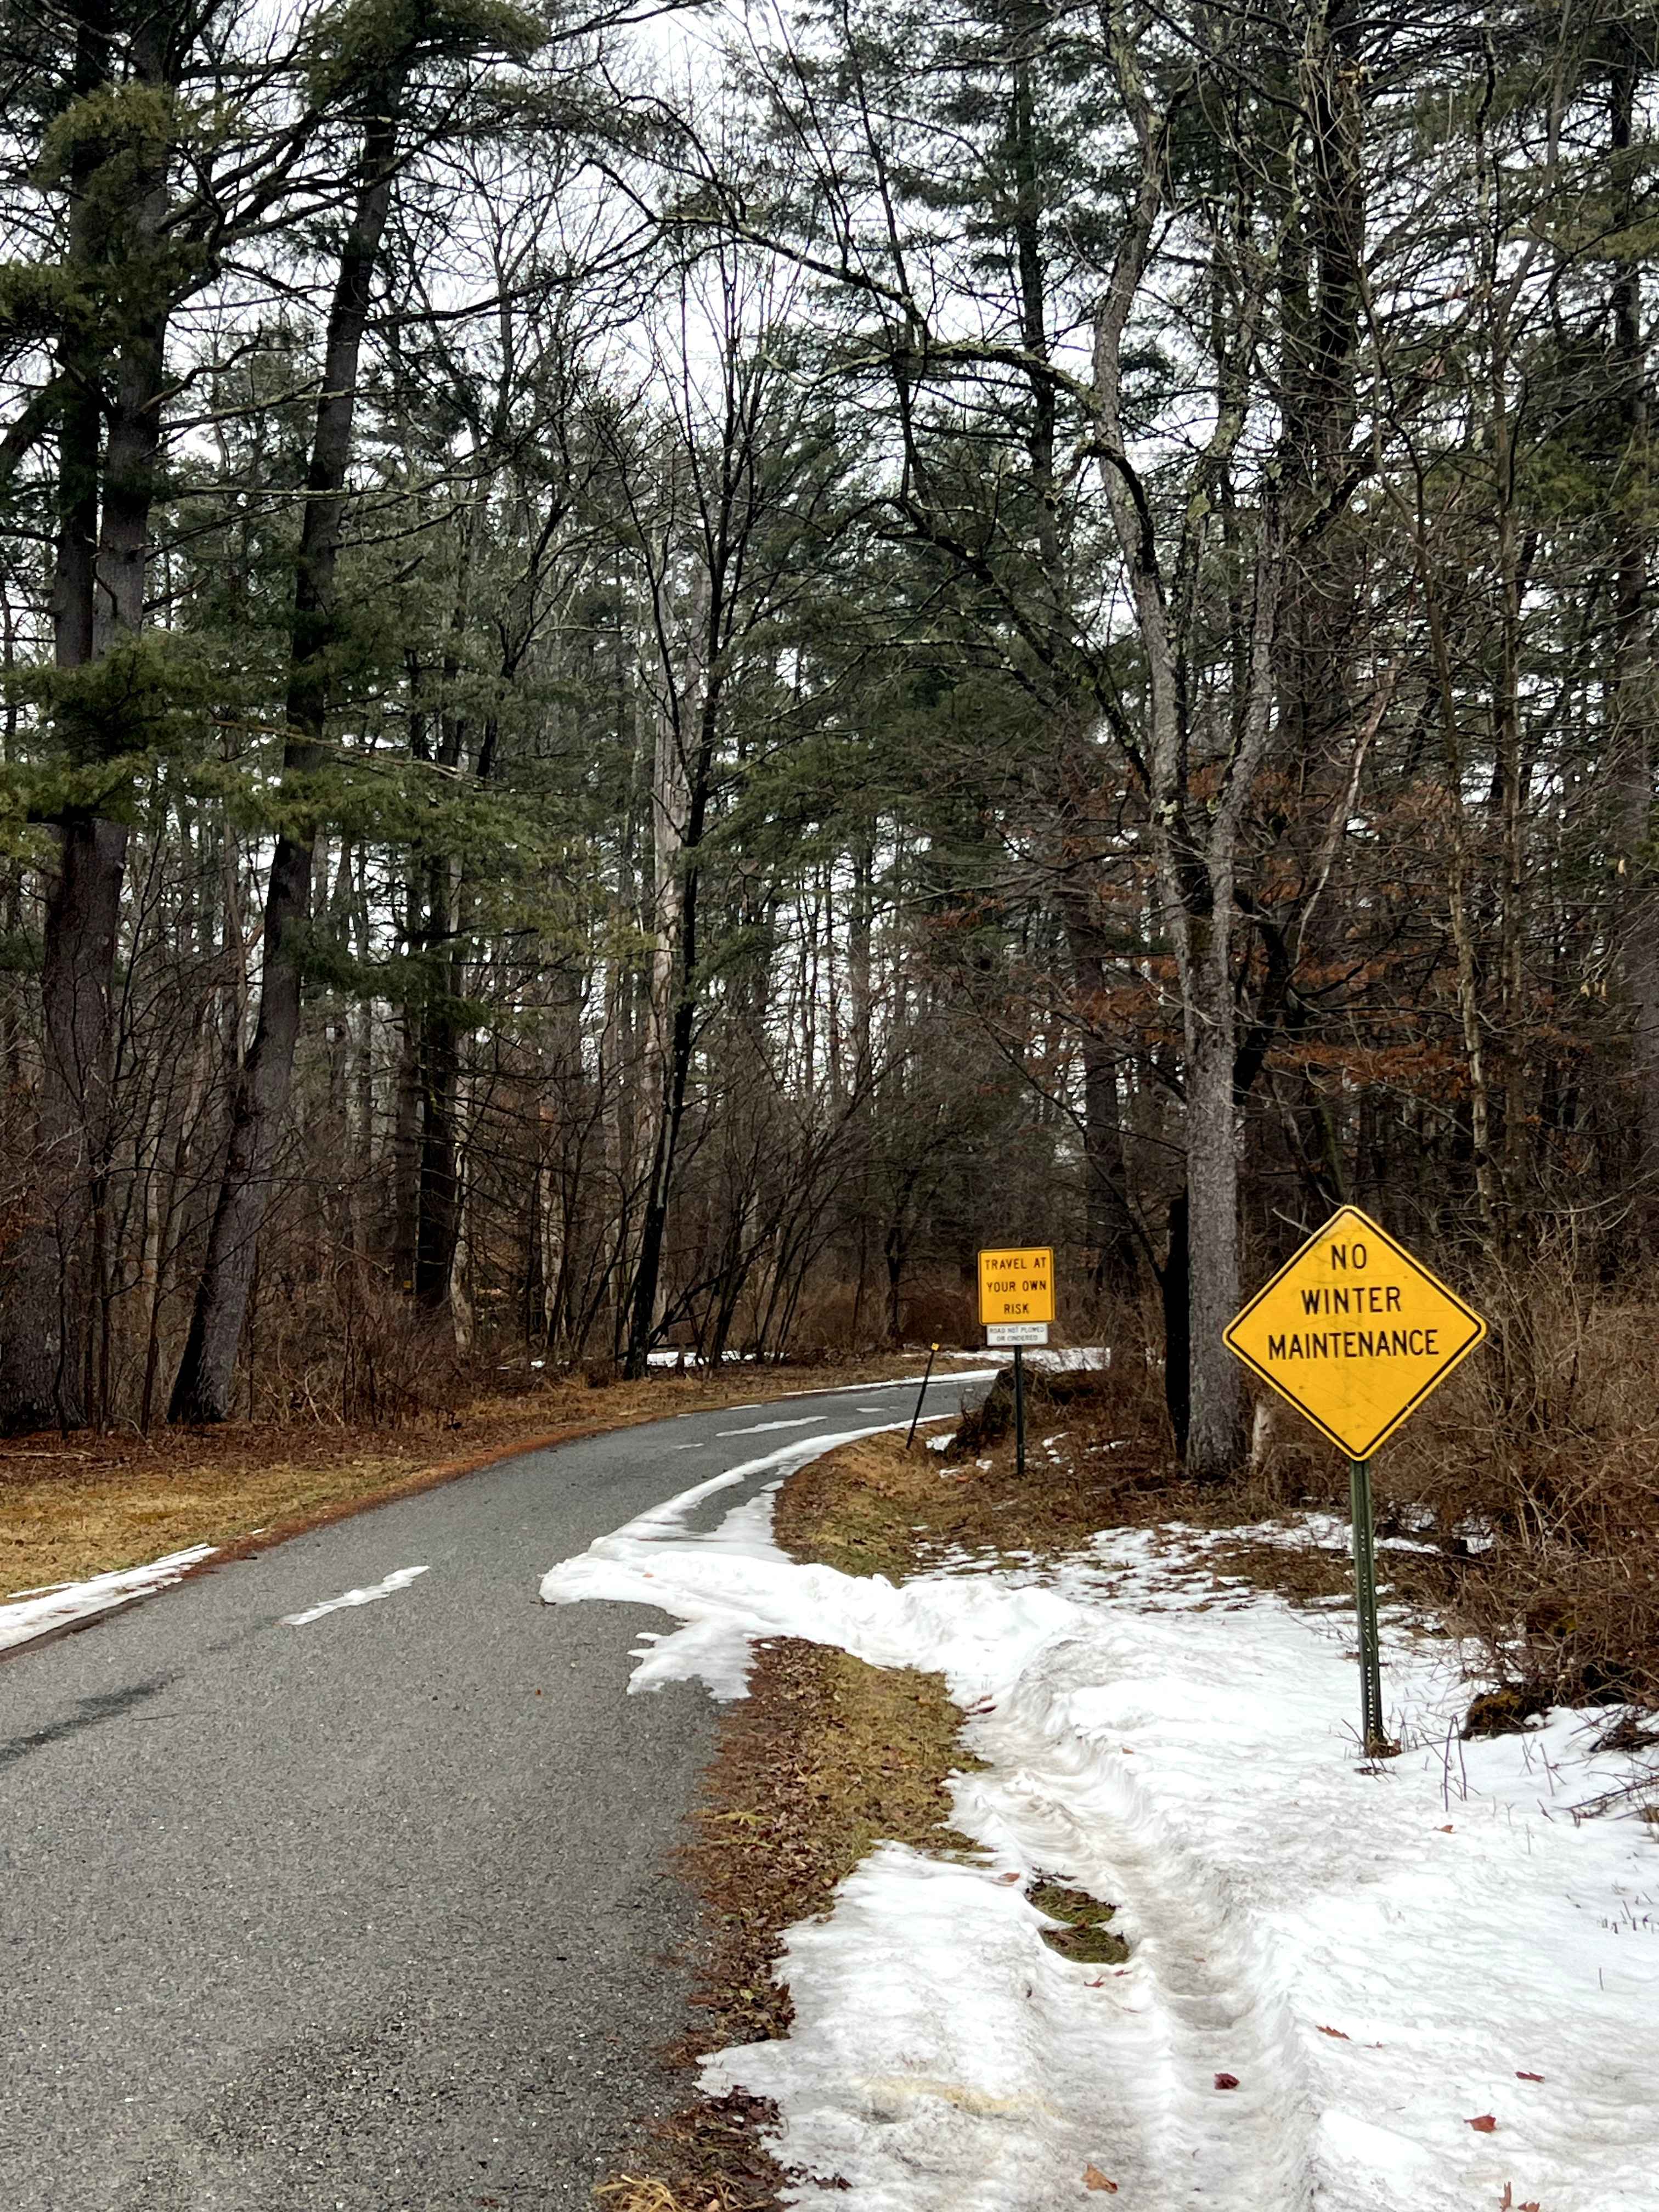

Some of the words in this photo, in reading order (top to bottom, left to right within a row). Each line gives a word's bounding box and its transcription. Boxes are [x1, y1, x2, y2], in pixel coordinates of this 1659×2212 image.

[985, 1258, 1026, 1269] TRAVEL
[1034, 1257, 1046, 1268] AT
[1331, 1244, 1367, 1270] NO
[986, 1281, 1016, 1292] YOUR
[1022, 1280, 1047, 1291] OWN
[1004, 1304, 1029, 1314] RISK
[1301, 1286, 1401, 1314] WINTER
[1268, 1330, 1439, 1360] MAINTENANCE
